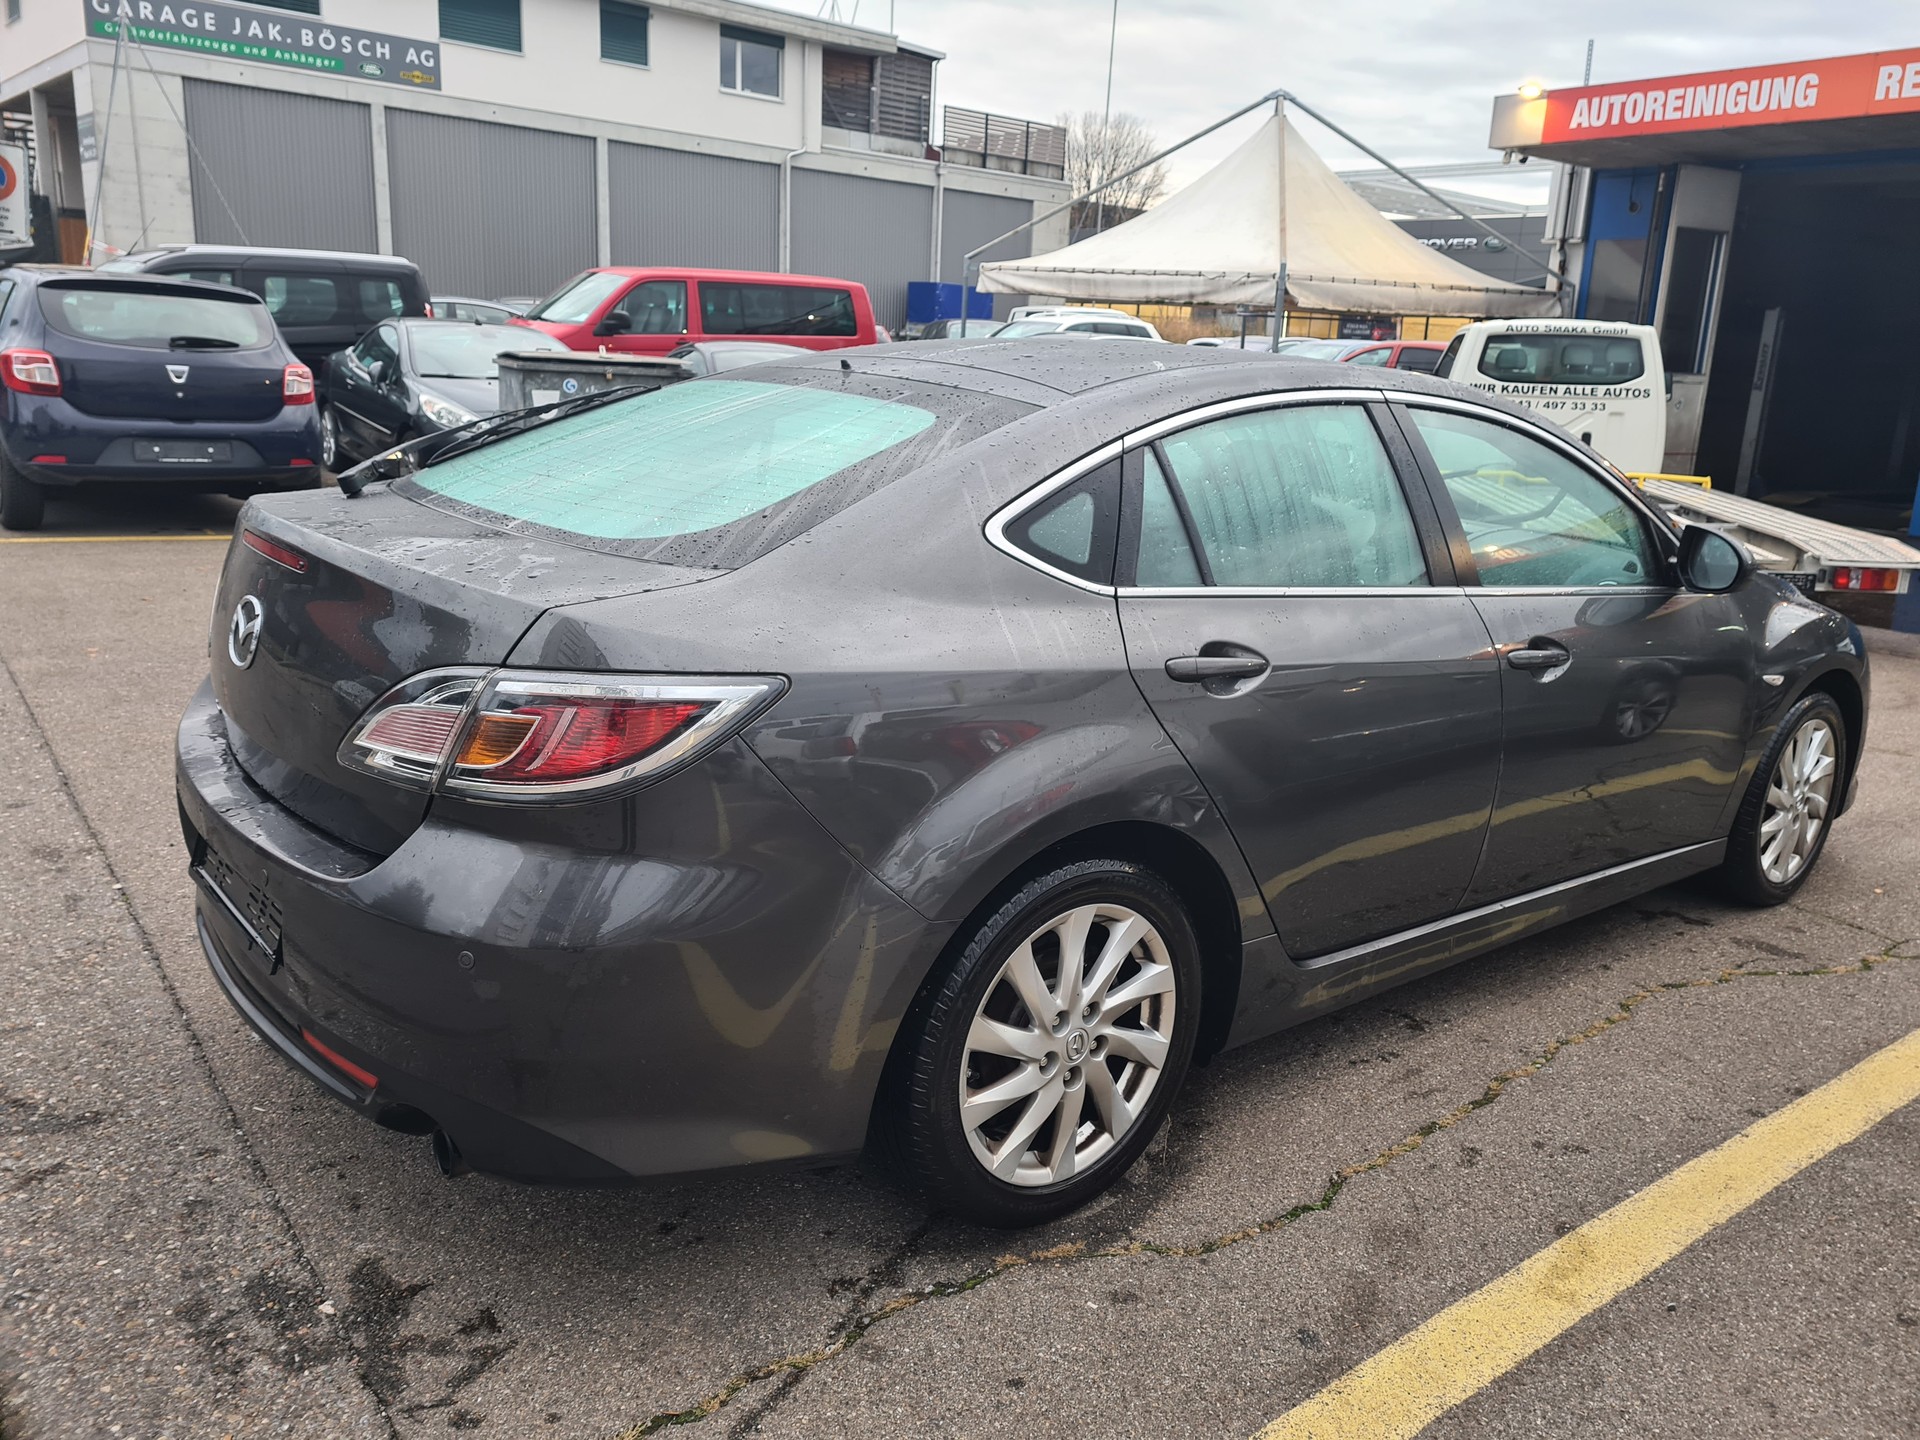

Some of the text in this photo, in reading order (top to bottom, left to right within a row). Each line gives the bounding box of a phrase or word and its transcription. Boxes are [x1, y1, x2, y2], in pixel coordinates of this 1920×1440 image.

[92, 0, 434, 67] GARAGE JAK. BÖSCH AG
[104, 22, 336, 68] Gndefahrzeuge und Anhänger
[1568, 62, 1920, 129] AUTOREINIGUNG RE
[1505, 324, 1629, 336] AUTO SMAKA GmbH
[1501, 384, 1559, 396] KAUFEN
[1563, 386, 1599, 397] ALLE
[1603, 387, 1651, 399] AUTOS
[1543, 400, 1566, 411] 497
[1571, 401, 1586, 411] 33
[1591, 402, 1607, 412] 33
